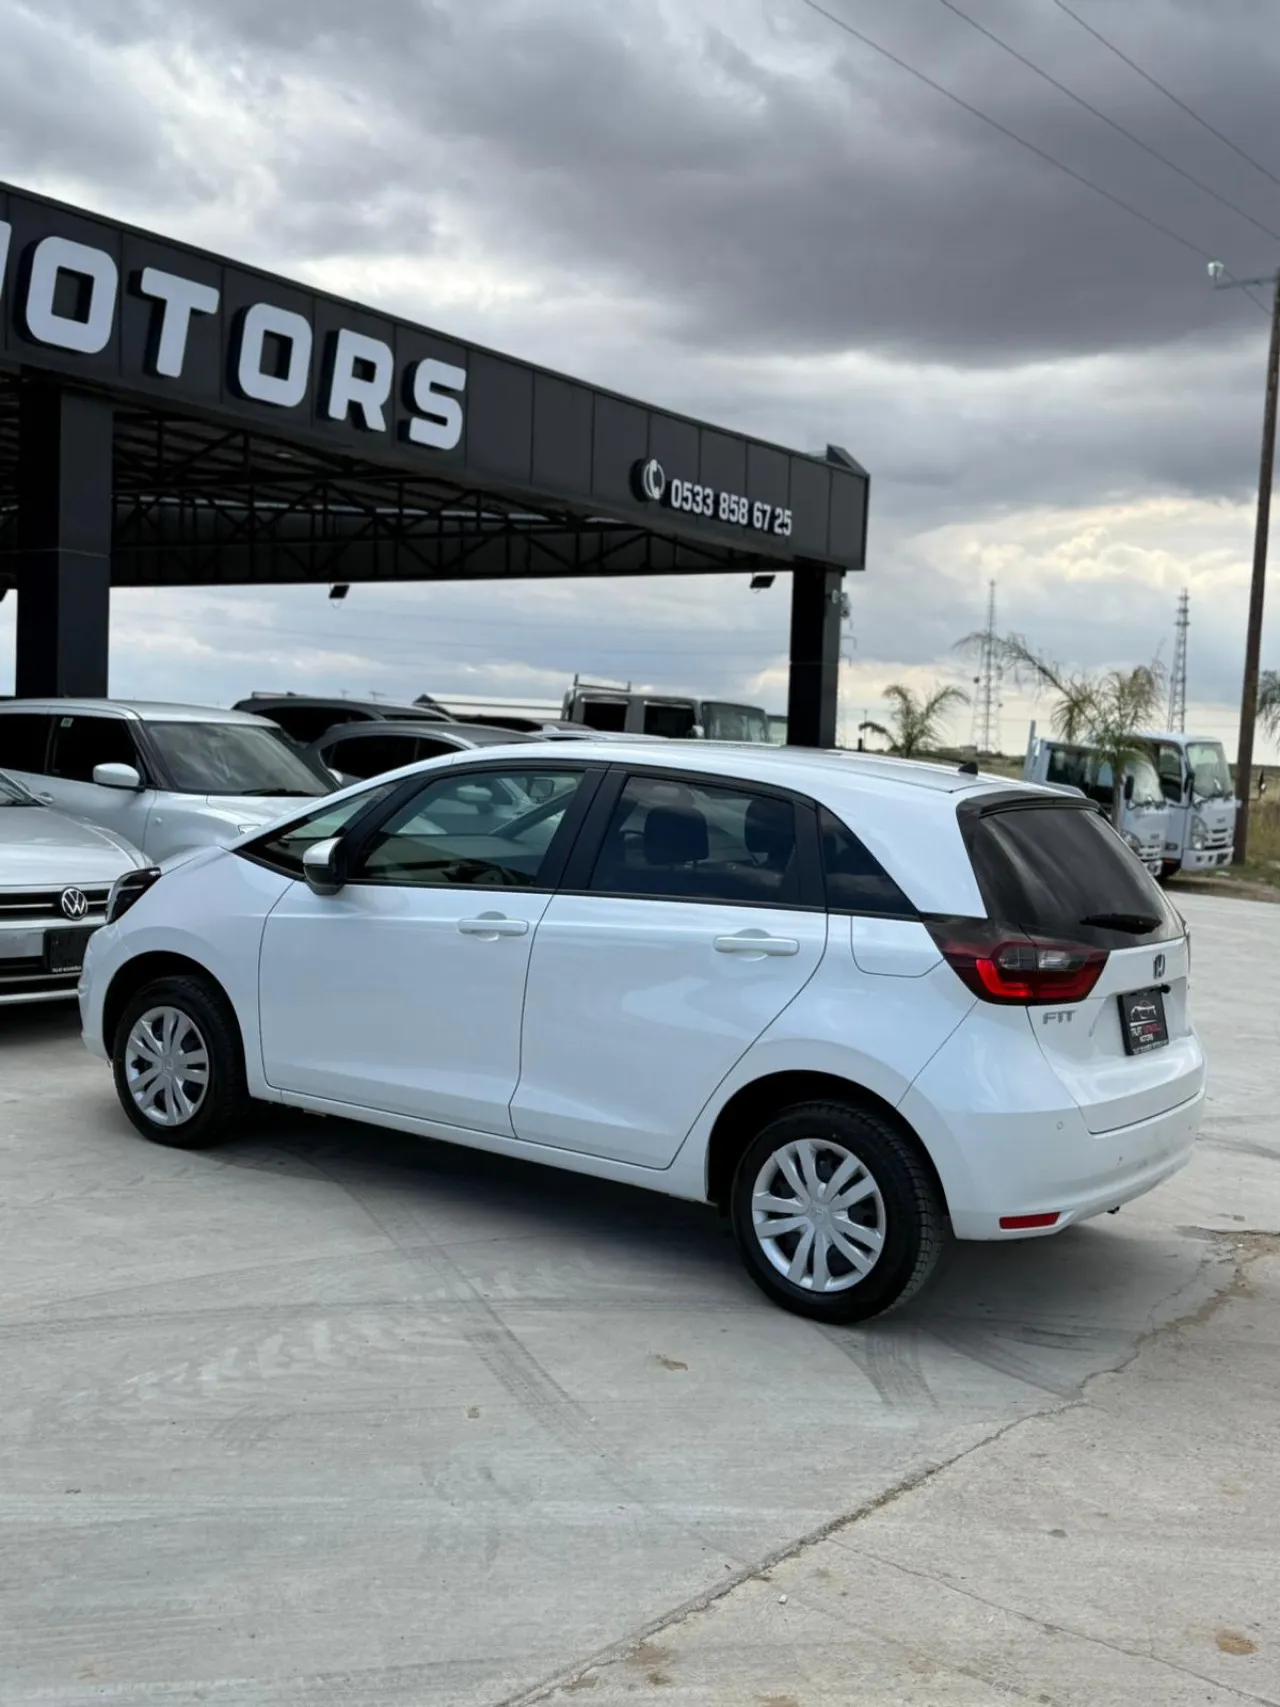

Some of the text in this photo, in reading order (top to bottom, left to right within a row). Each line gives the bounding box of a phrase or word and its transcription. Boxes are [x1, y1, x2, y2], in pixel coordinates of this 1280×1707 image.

[0, 221, 467, 450] OTORS
[671, 478, 793, 536] 0533 858 67 25
[1042, 1009, 1077, 1025] FIT
